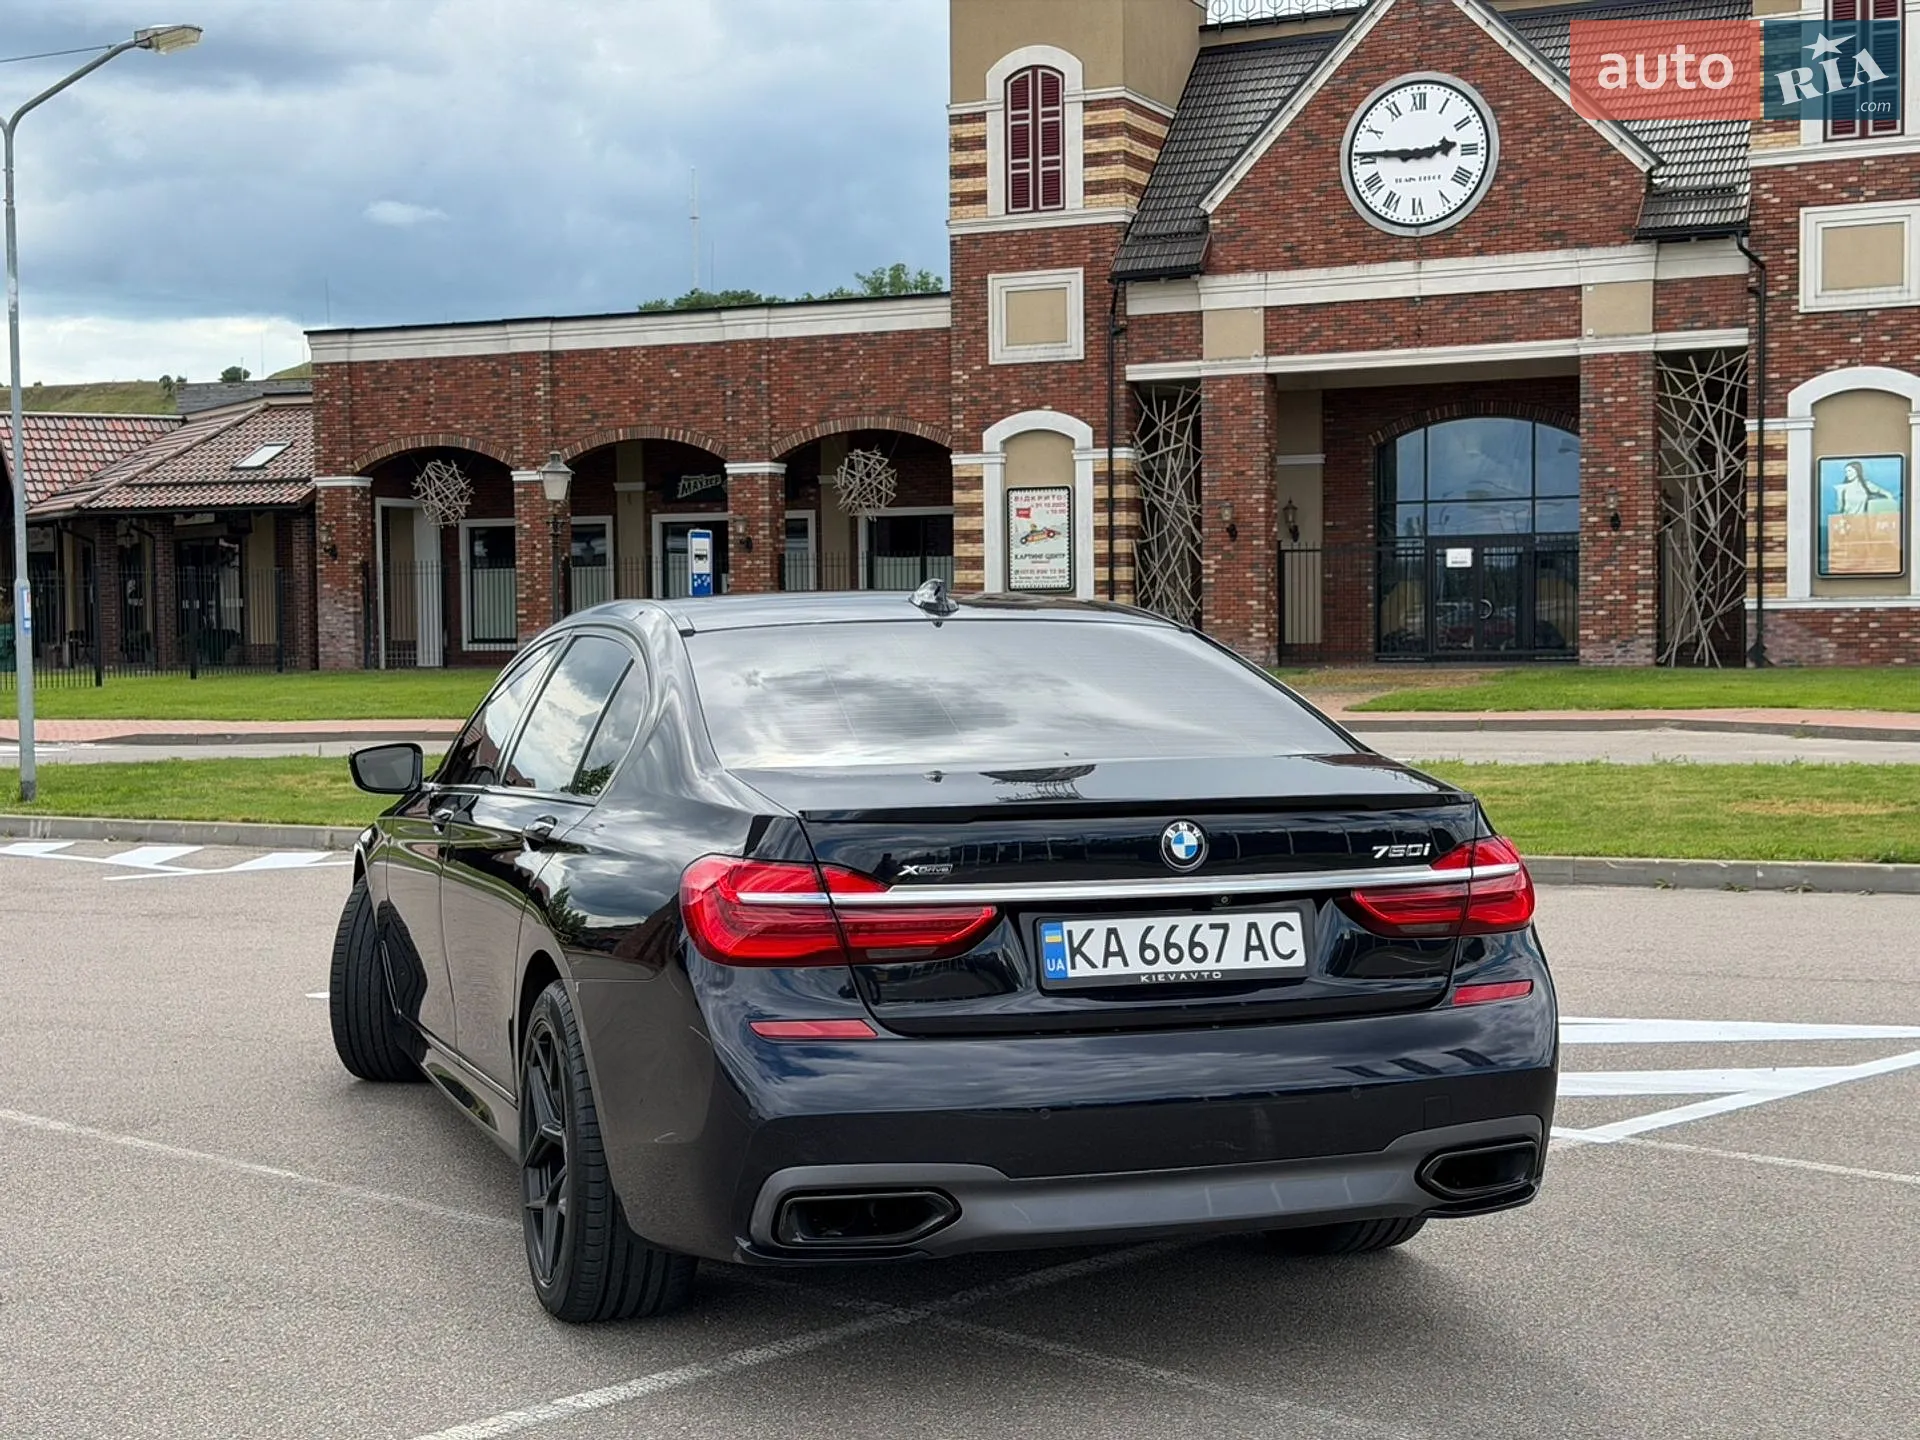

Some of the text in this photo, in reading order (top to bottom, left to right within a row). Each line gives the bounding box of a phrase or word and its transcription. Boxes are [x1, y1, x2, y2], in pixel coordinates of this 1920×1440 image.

[1165, 821, 1202, 838] BMW
[1371, 842, 1431, 859] 750i
[1066, 920, 1298, 971] KA 6667 AC
[1046, 959, 1066, 973] UA
[1140, 971, 1222, 984] KIEVAVTO
